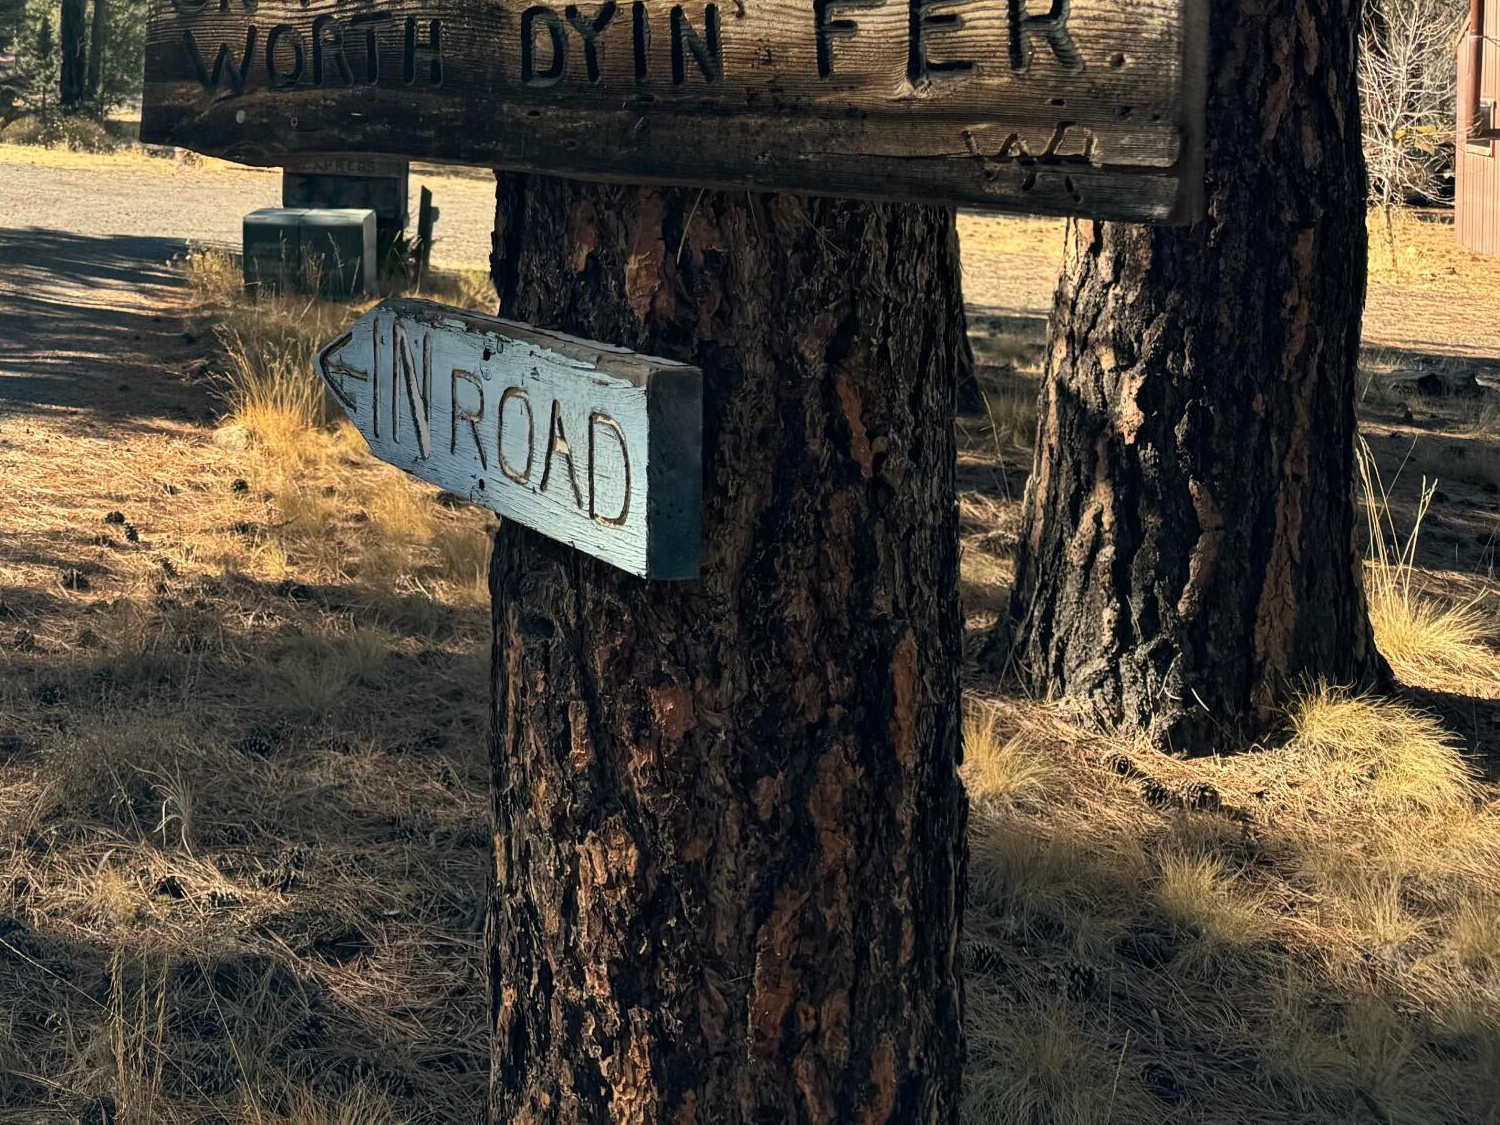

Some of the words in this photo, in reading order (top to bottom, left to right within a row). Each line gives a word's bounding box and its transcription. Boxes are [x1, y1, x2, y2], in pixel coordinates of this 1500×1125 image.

[182, 12, 445, 95] WORTH
[371, 313, 433, 462] IN
[449, 368, 632, 528] ROAD
